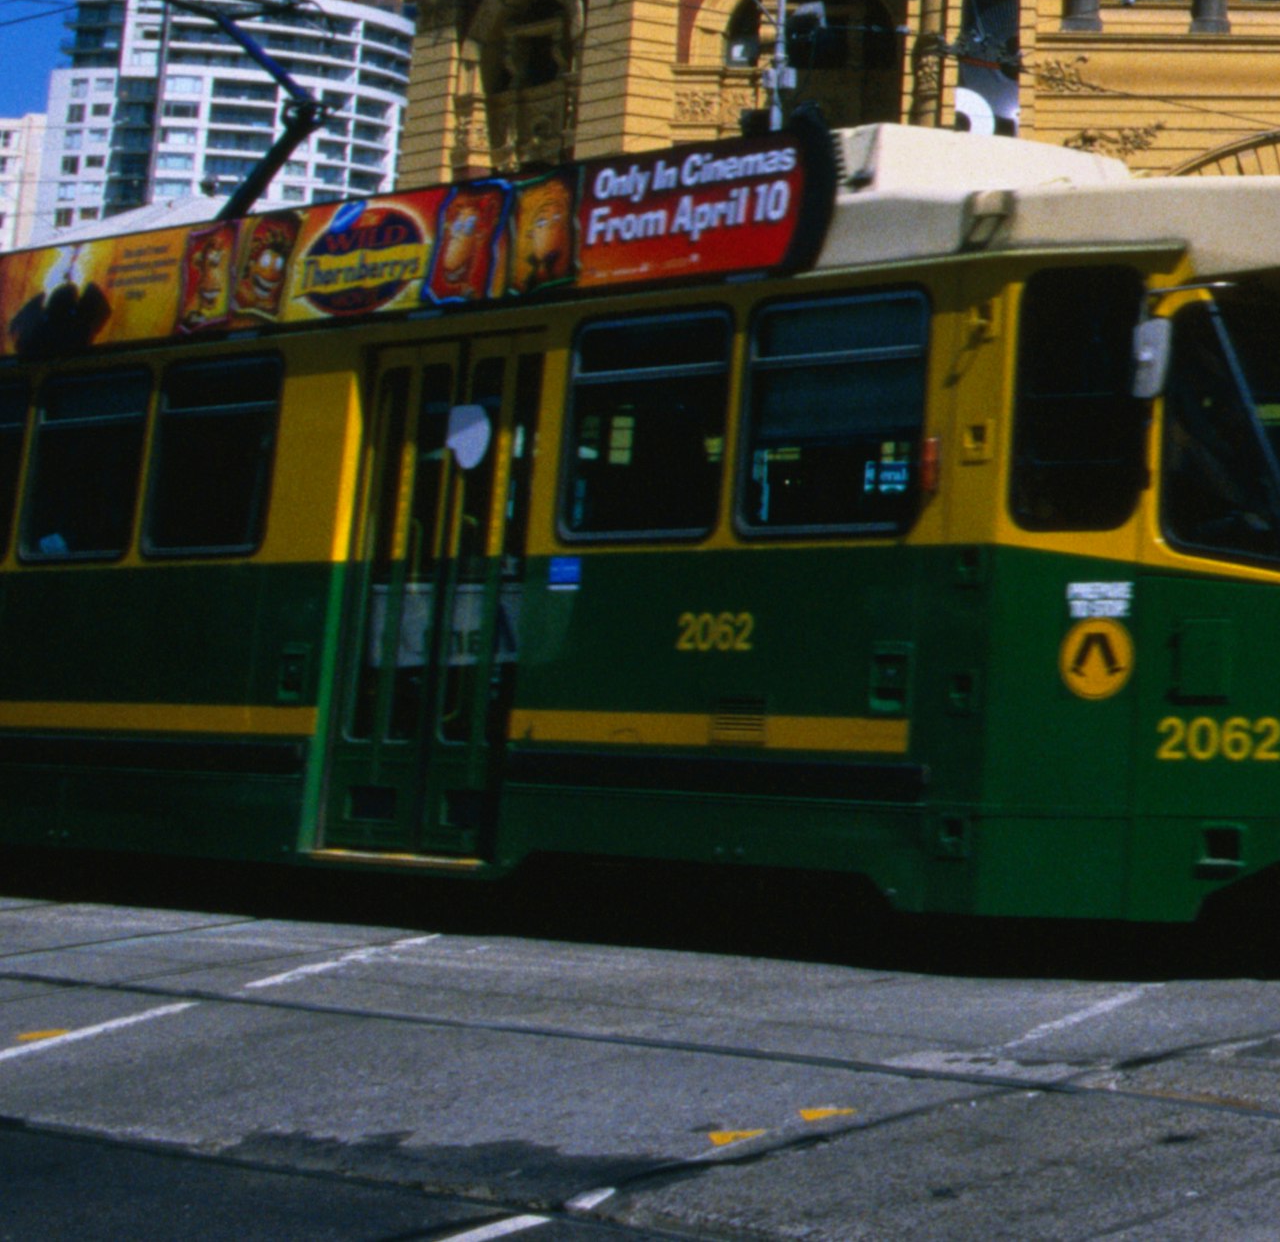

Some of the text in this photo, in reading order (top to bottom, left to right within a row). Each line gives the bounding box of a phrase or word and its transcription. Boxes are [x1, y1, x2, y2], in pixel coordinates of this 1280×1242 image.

[594, 147, 797, 203] Only In Cinemas
[586, 180, 791, 246] From April 10
[324, 224, 409, 254] WILD
[303, 252, 421, 290] Thornberrys
[676, 611, 754, 651] 2062
